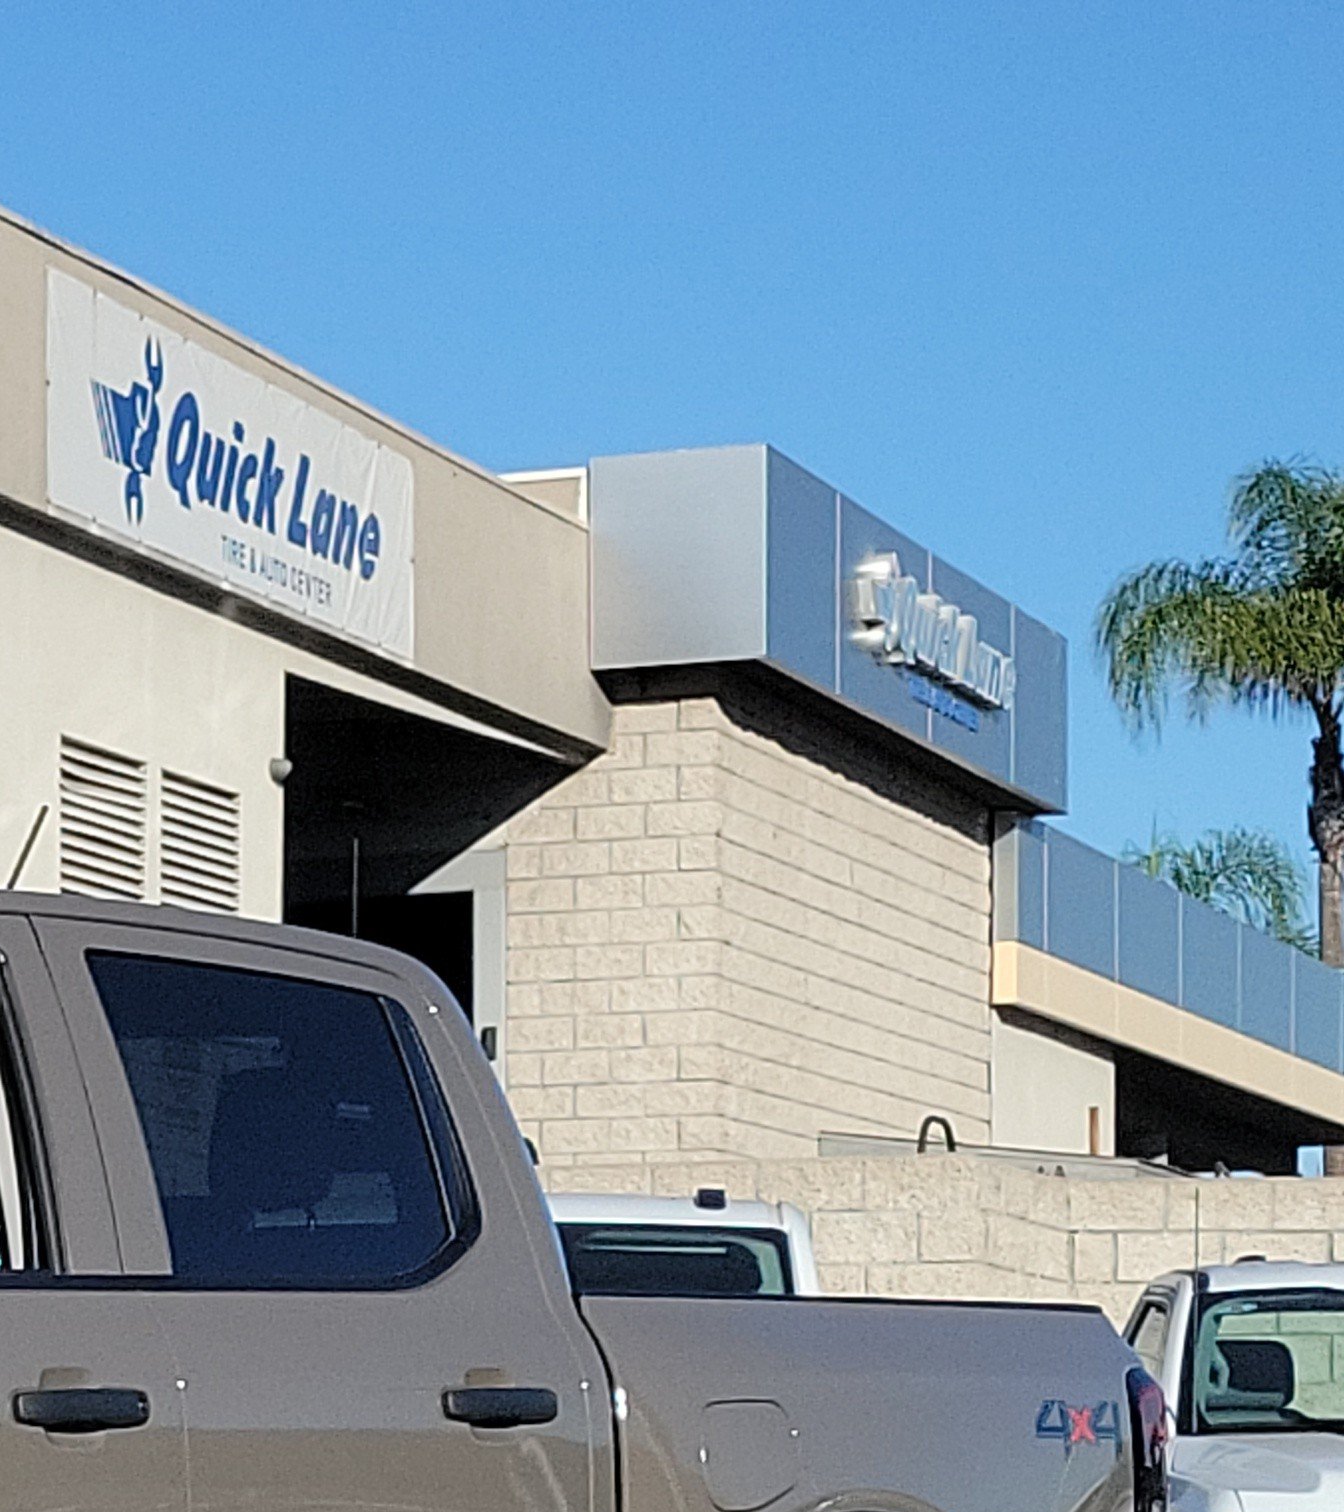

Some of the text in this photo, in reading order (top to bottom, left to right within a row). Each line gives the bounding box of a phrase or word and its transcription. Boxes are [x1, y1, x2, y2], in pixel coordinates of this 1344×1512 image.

[165, 390, 383, 580] Quick Lane
[220, 535, 246, 570] TIRE
[259, 550, 288, 588] AUTO
[290, 566, 332, 607] CENTER
